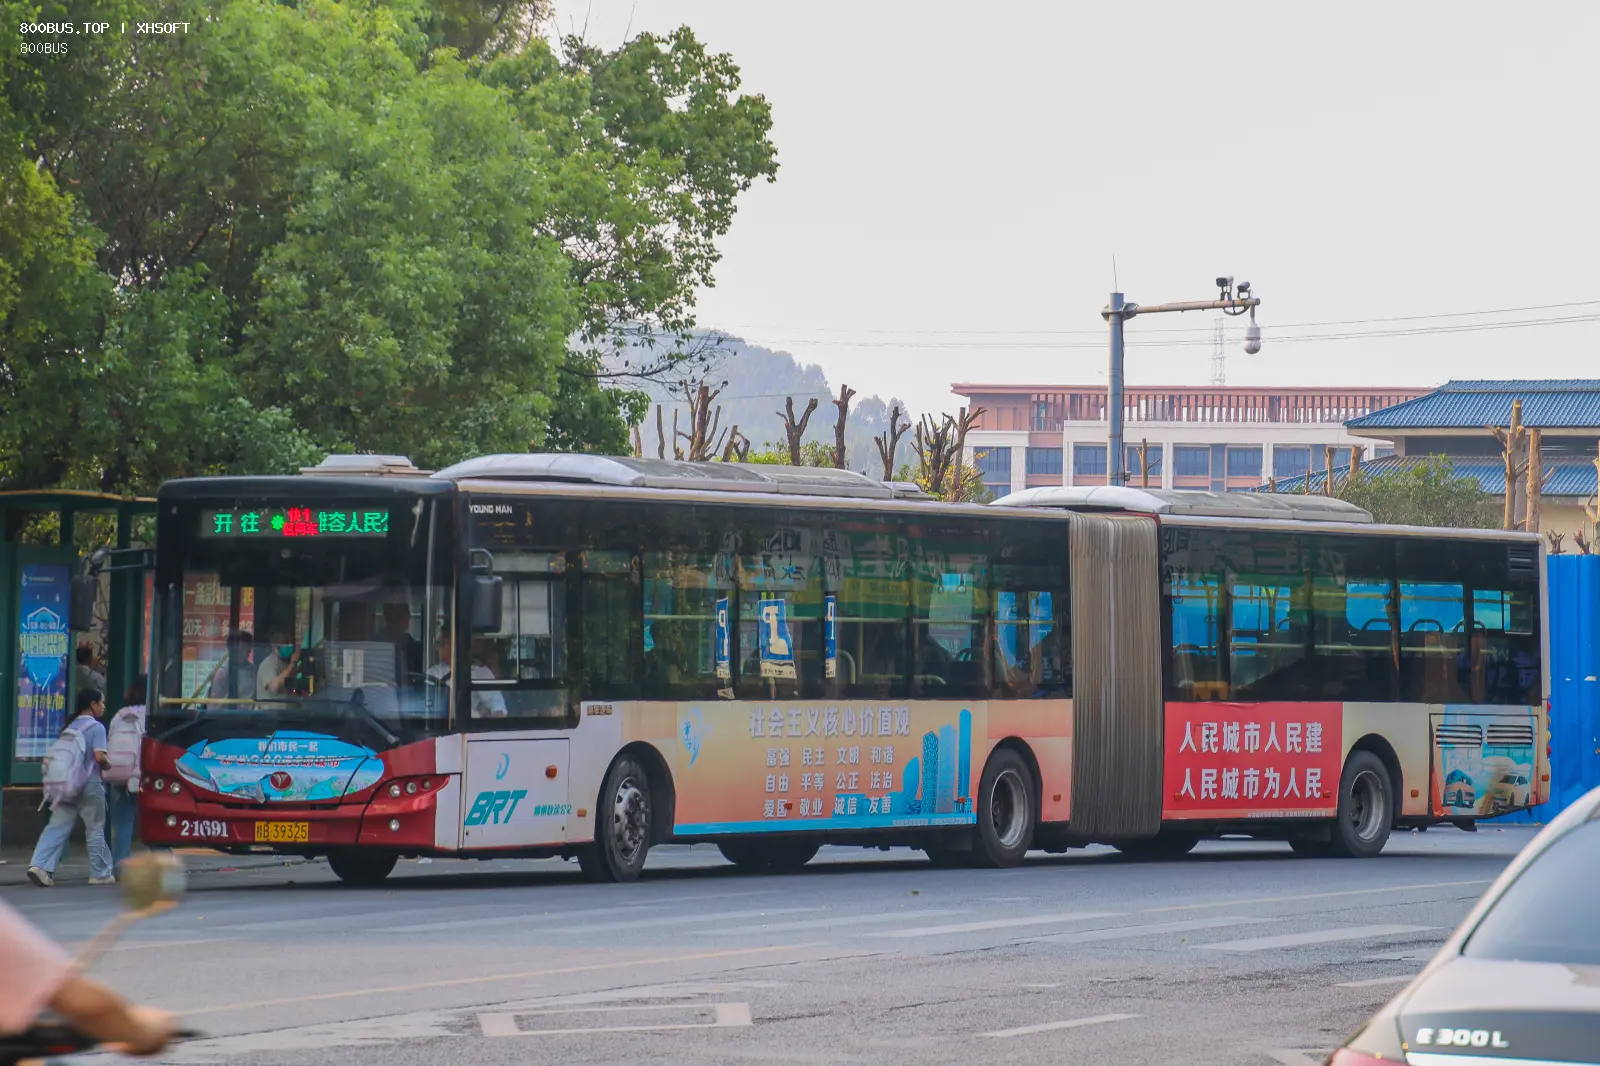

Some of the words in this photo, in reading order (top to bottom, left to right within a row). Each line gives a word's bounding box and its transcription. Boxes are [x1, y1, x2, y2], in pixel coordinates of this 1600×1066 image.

[469, 504, 494, 514] YOUNG
[495, 504, 513, 514] MAN
[749, 705, 910, 738] 社会主义核心价值观
[1179, 721, 1323, 753] 人民城市人民建
[766, 747, 790, 767] 富强
[802, 746, 825, 766] 民主
[837, 746, 860, 765] 文明
[871, 745, 895, 764] 和谐
[765, 773, 789, 792] 自由
[801, 771, 824, 791] 平等
[836, 771, 859, 790] 公正
[870, 770, 893, 789] 法治
[1180, 767, 1322, 800] 人民城市为人民
[464, 789, 528, 826] BRT
[764, 798, 787, 818] 爱国
[799, 797, 823, 817] 敬业
[834, 796, 858, 815] 诚信
[868, 795, 892, 814] 友善
[1416, 1028, 1434, 1045] E
[1436, 1028, 1489, 1047] 300
[1491, 1031, 1510, 1048] L
